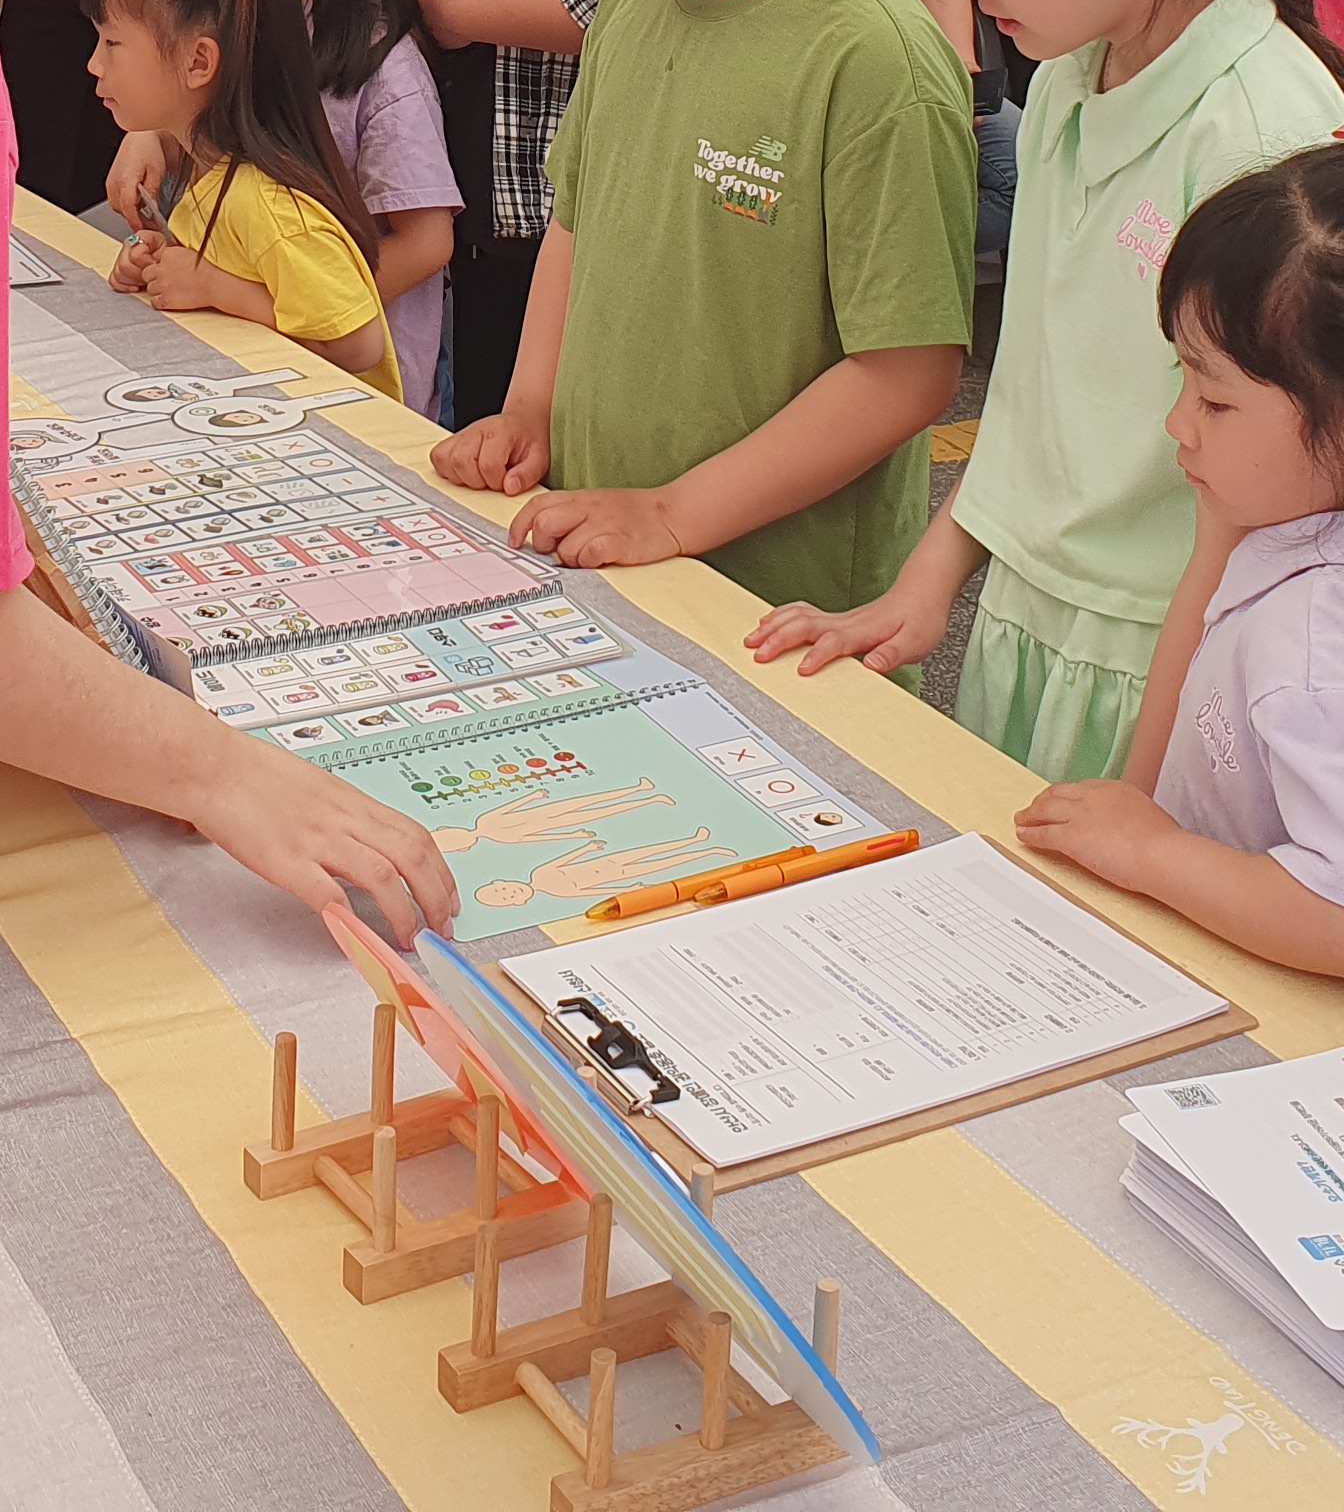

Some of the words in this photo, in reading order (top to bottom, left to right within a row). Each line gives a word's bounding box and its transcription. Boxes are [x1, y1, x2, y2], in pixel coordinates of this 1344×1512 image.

[693, 162, 717, 183] we
[716, 174, 783, 204] grow
[697, 138, 785, 184] Together
